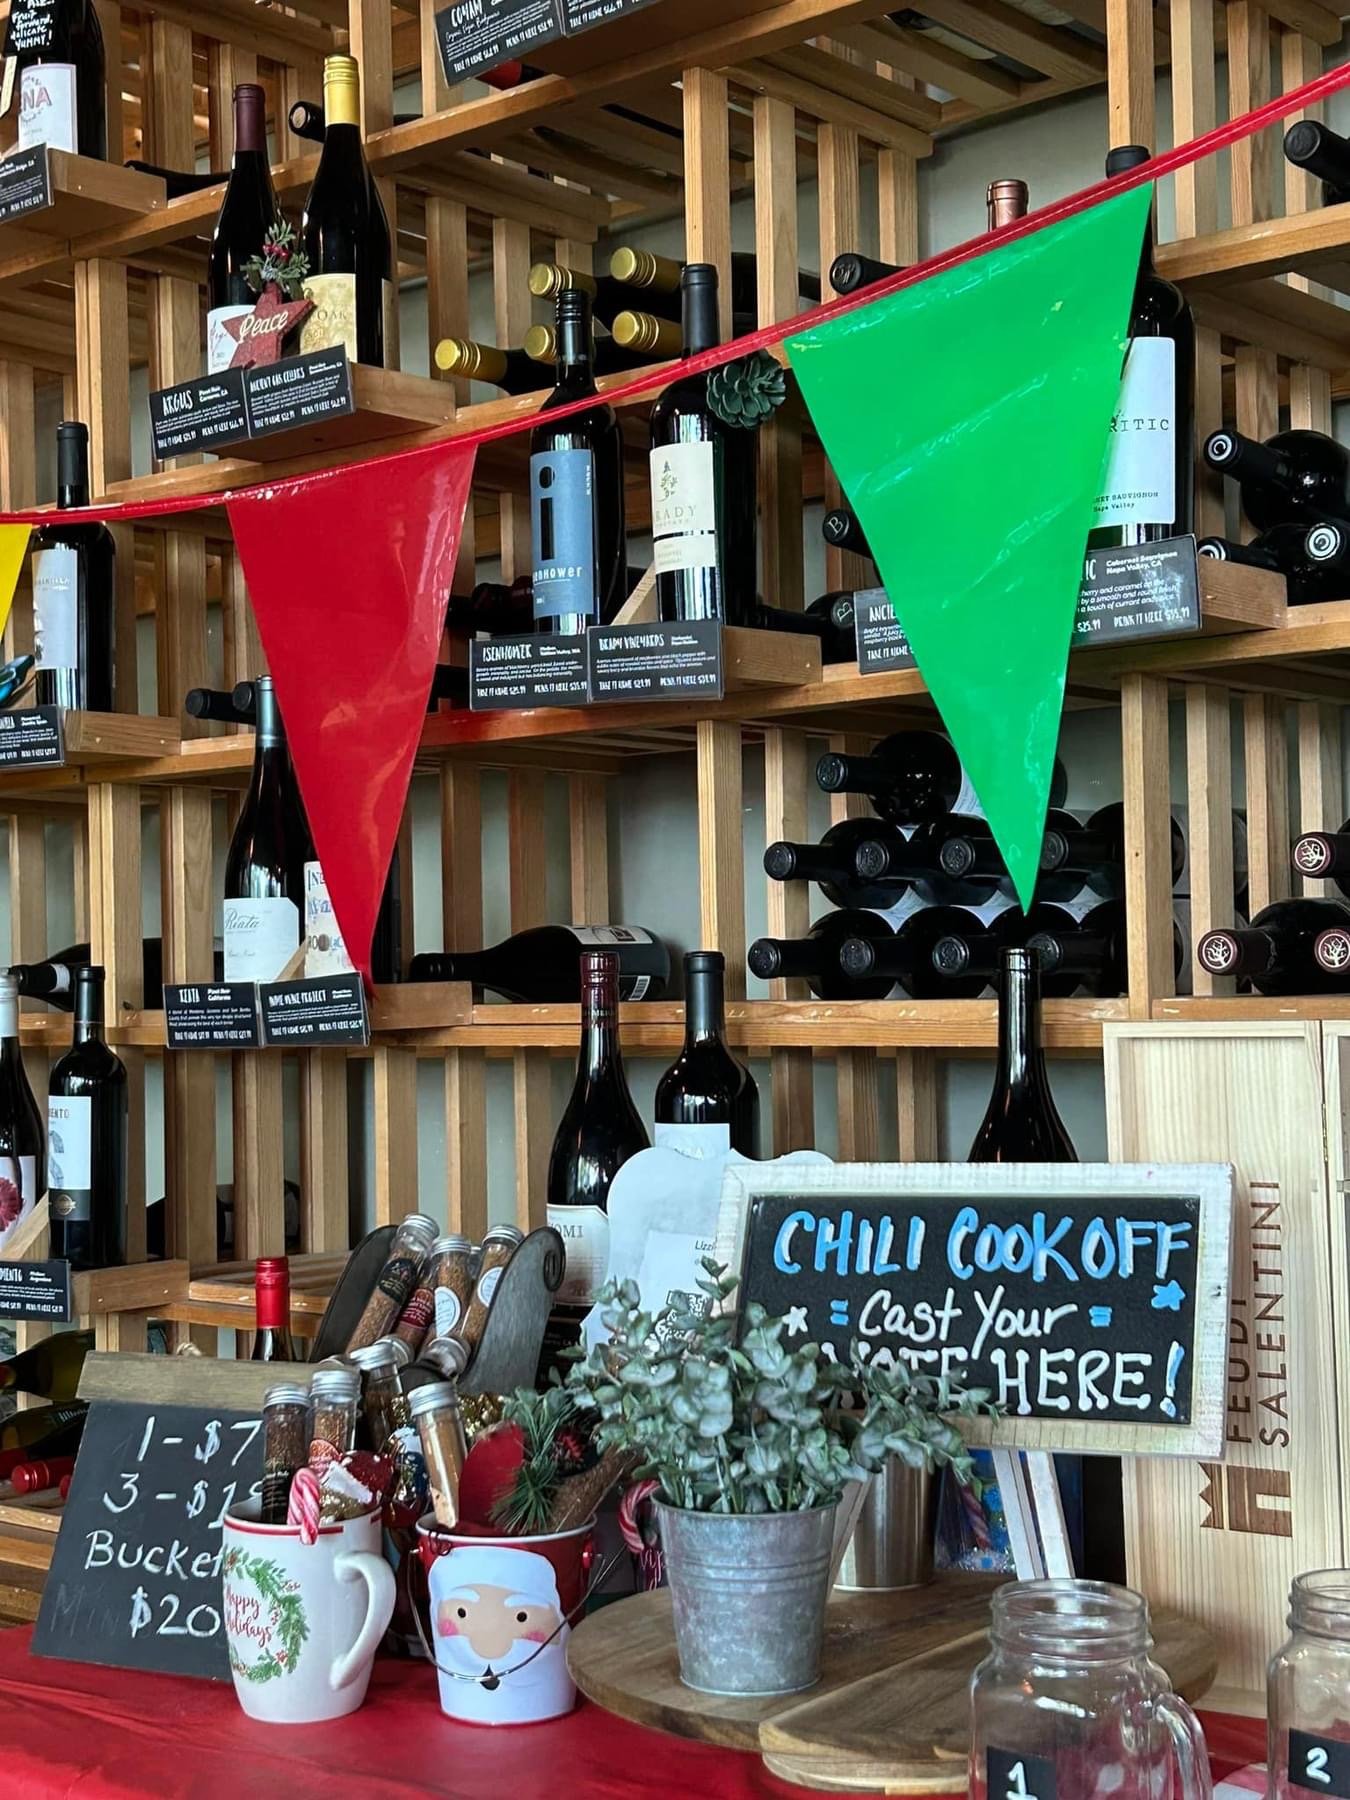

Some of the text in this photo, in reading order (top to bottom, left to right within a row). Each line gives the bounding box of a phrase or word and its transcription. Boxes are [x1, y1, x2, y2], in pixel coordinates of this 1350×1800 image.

[15, 29, 53, 52] YUMMY!
[240, 310, 289, 344] Peace
[162, 390, 194, 416] ARGUS
[1111, 502, 1135, 510] Valley
[1112, 491, 1159, 501] SAUVIGNON
[828, 515, 843, 537] B
[1106, 551, 1178, 568] Cabernet Sauvignon
[1106, 566, 1126, 575] Napa
[1080, 597, 1089, 606] by
[1095, 593, 1122, 604] smooth
[1122, 590, 1137, 599] and
[1081, 587, 1099, 597] herry
[1099, 585, 1114, 595] and
[1113, 582, 1143, 593] caramel
[1086, 603, 1106, 613] touch
[1106, 601, 1114, 611] of
[883, 647, 889, 658] IT
[773, 1209, 926, 1276] CHILI
[858, 1284, 1078, 1360] Cast Your
[1250, 1181, 1290, 1449] SALENTINI
[990, 1340, 1186, 1419] HERE!
[186, 1479, 264, 1530] $1
[129, 1585, 222, 1638] $20
[1306, 1747, 1331, 1785] 2
[1006, 1761, 1038, 1800] 1
